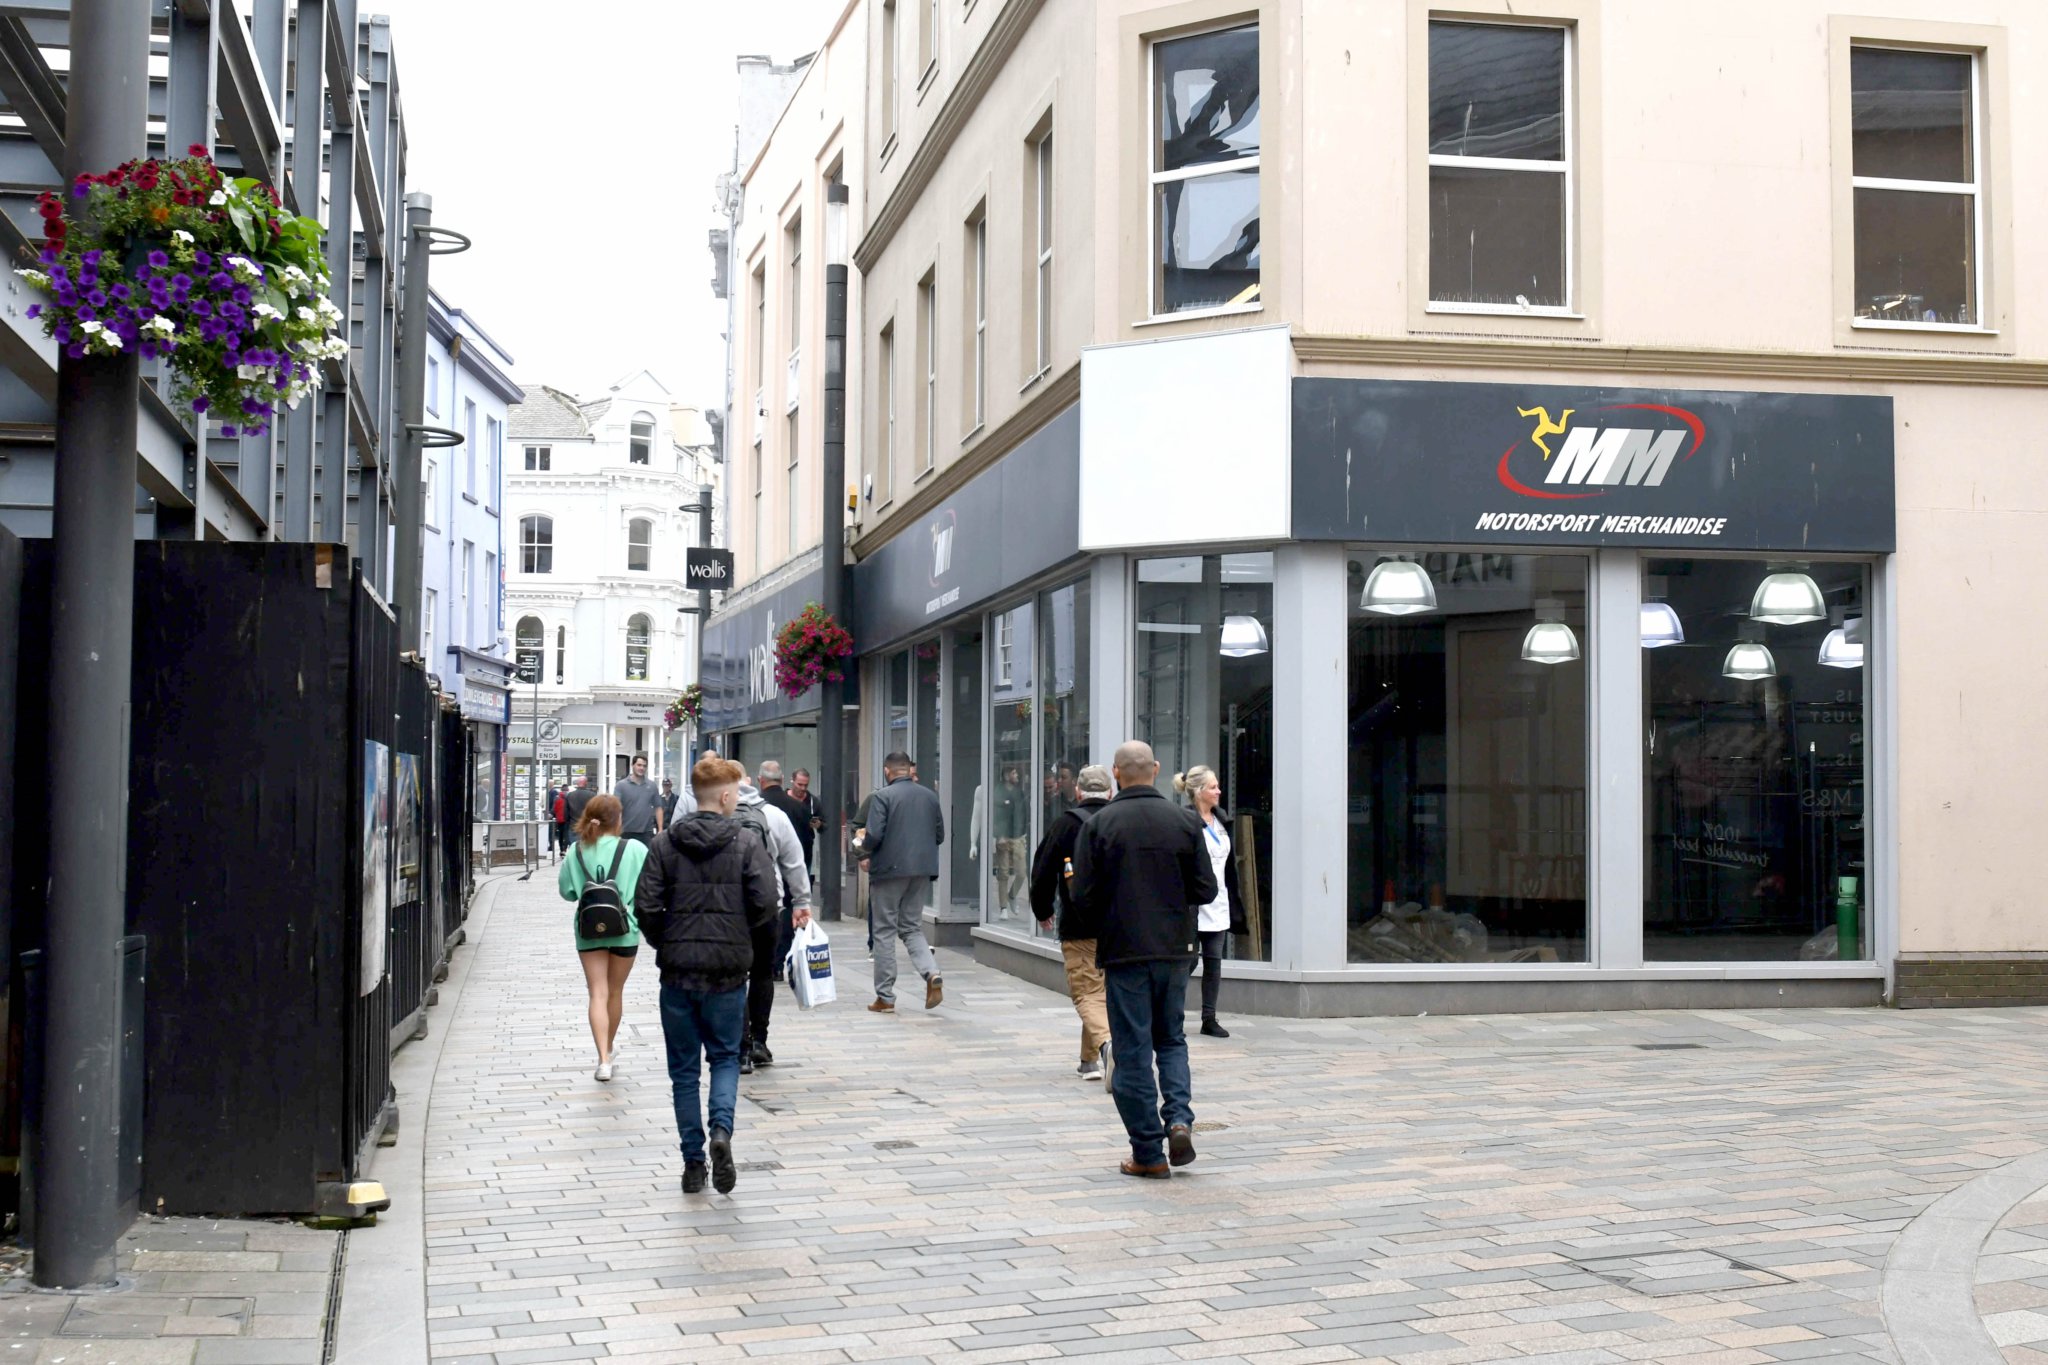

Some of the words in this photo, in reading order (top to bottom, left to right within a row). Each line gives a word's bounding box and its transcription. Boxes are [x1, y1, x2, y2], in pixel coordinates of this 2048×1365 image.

[1544, 427, 1687, 486] MM
[1475, 512, 1600, 533] MOTORSPORT
[1601, 515, 1728, 536] MERCHANDISE
[689, 559, 727, 579] wallis
[807, 950, 829, 961] home
